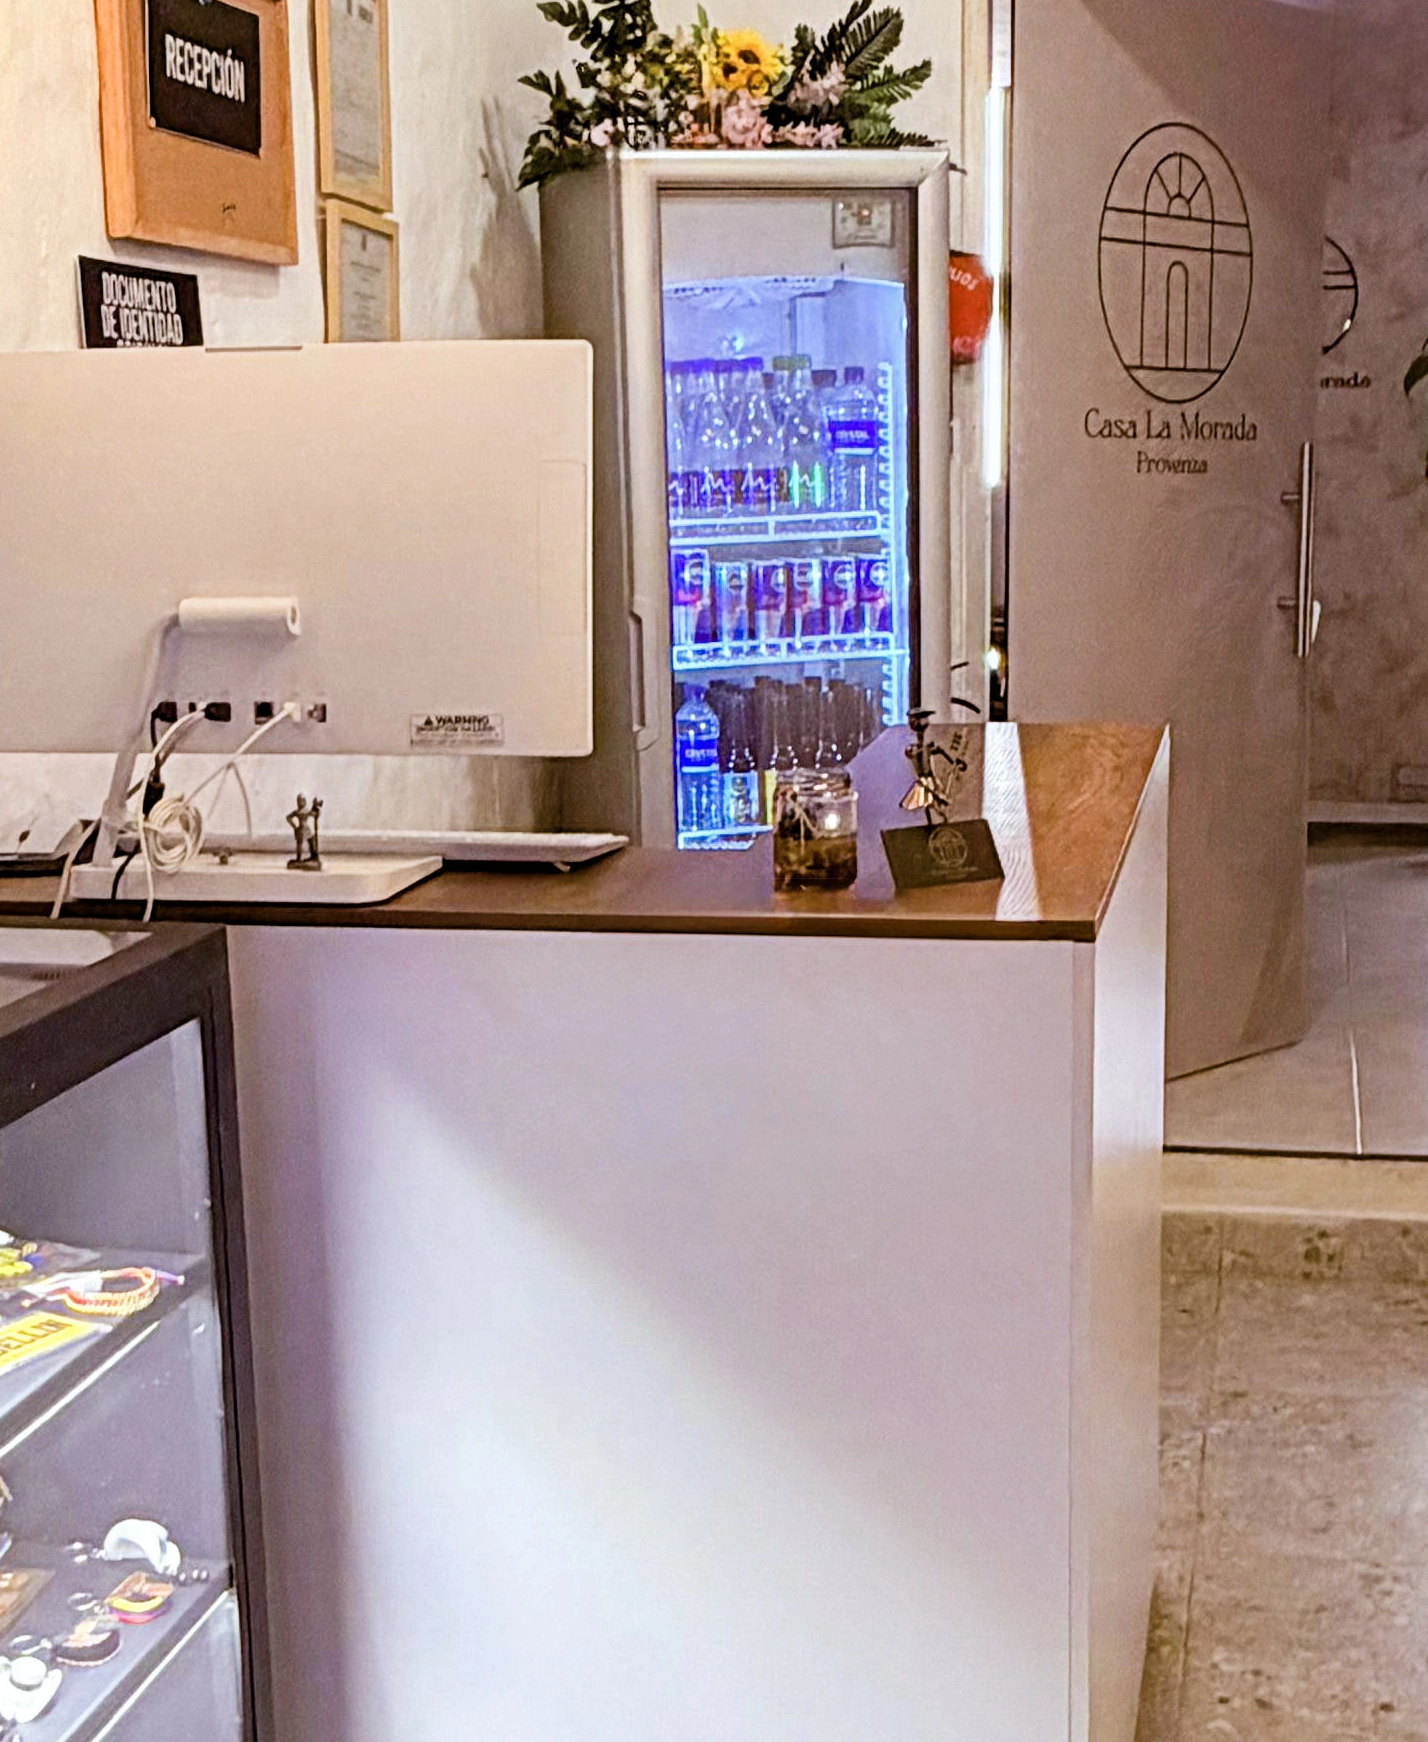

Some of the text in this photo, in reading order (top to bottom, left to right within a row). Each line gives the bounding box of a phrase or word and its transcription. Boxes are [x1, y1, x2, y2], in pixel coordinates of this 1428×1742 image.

[165, 33, 246, 104] RECEPCIÓN
[101, 271, 177, 314] DOCUMENTO
[100, 304, 184, 346] DE IDENTIDAD
[1084, 407, 1258, 441] Casa La Morada
[1136, 450, 1208, 474] Provenza
